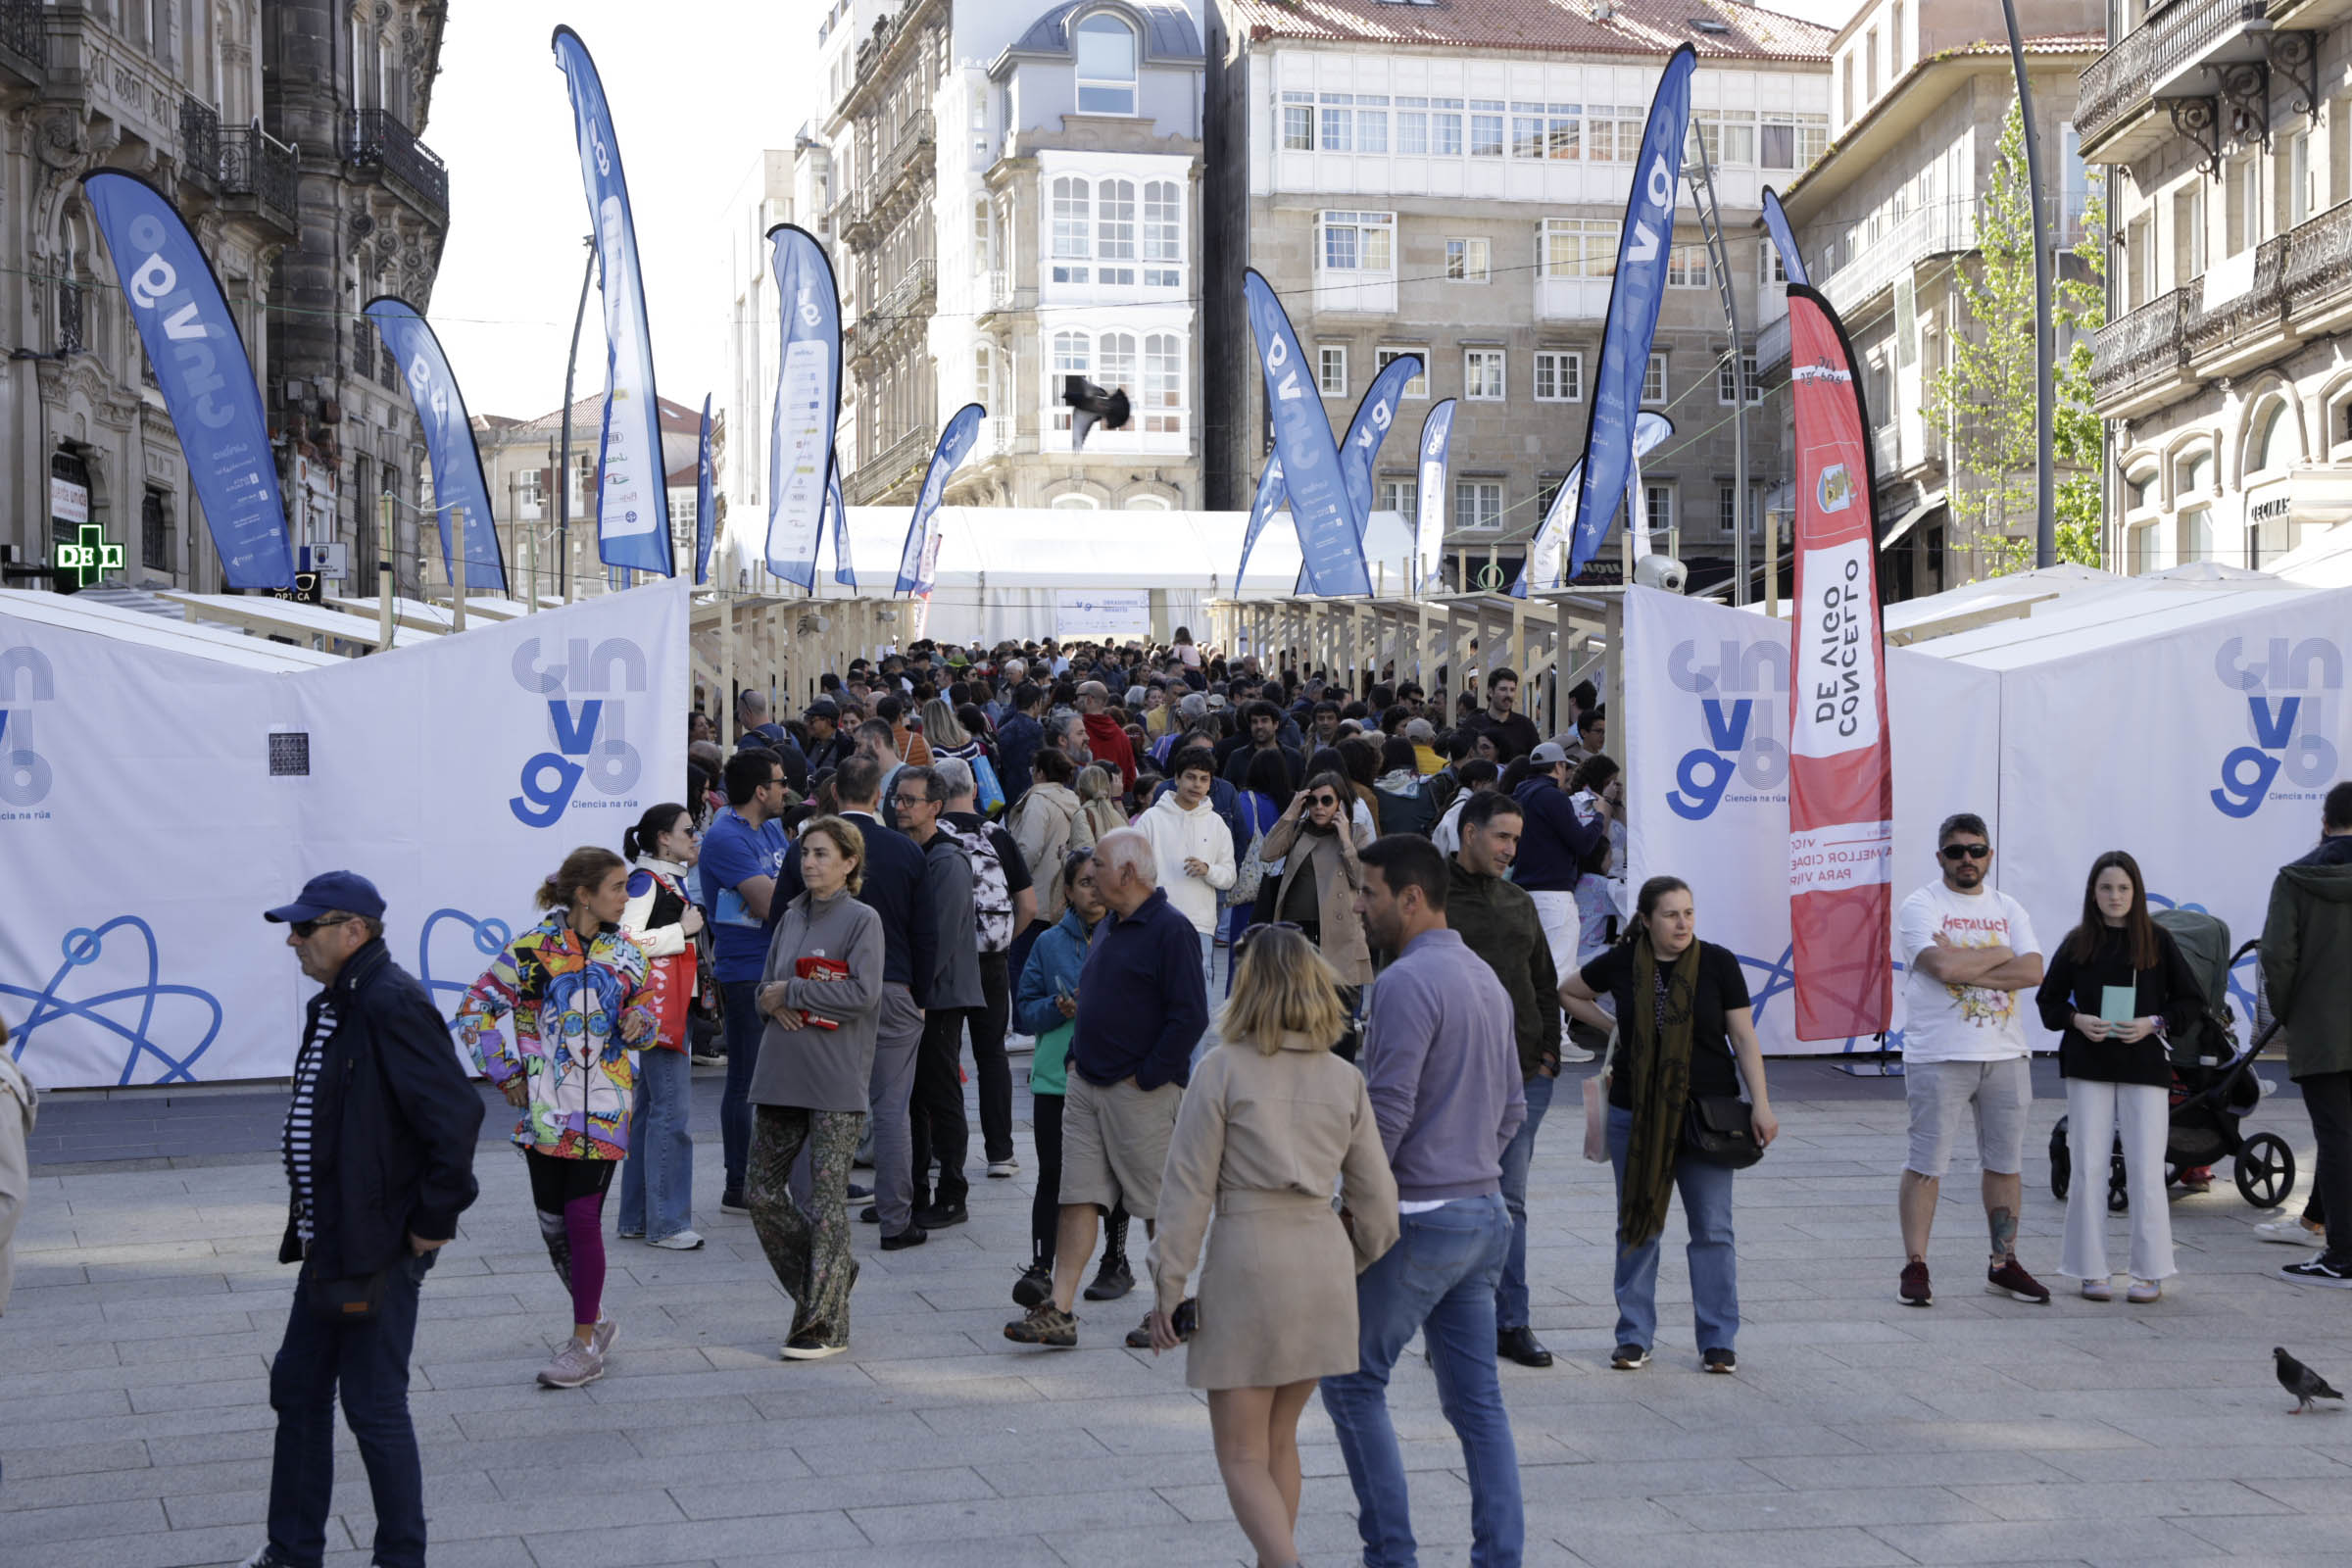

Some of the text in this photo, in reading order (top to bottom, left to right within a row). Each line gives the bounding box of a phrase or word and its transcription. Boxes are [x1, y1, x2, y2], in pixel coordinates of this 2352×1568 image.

[274, 592, 311, 602] OPTCA
[1724, 794, 1758, 803] Ciencia
[1772, 794, 1787, 803] rúa
[2269, 791, 2302, 801] Ciencia
[571, 799, 608, 808] Ciencia
[623, 799, 638, 808] rúa
